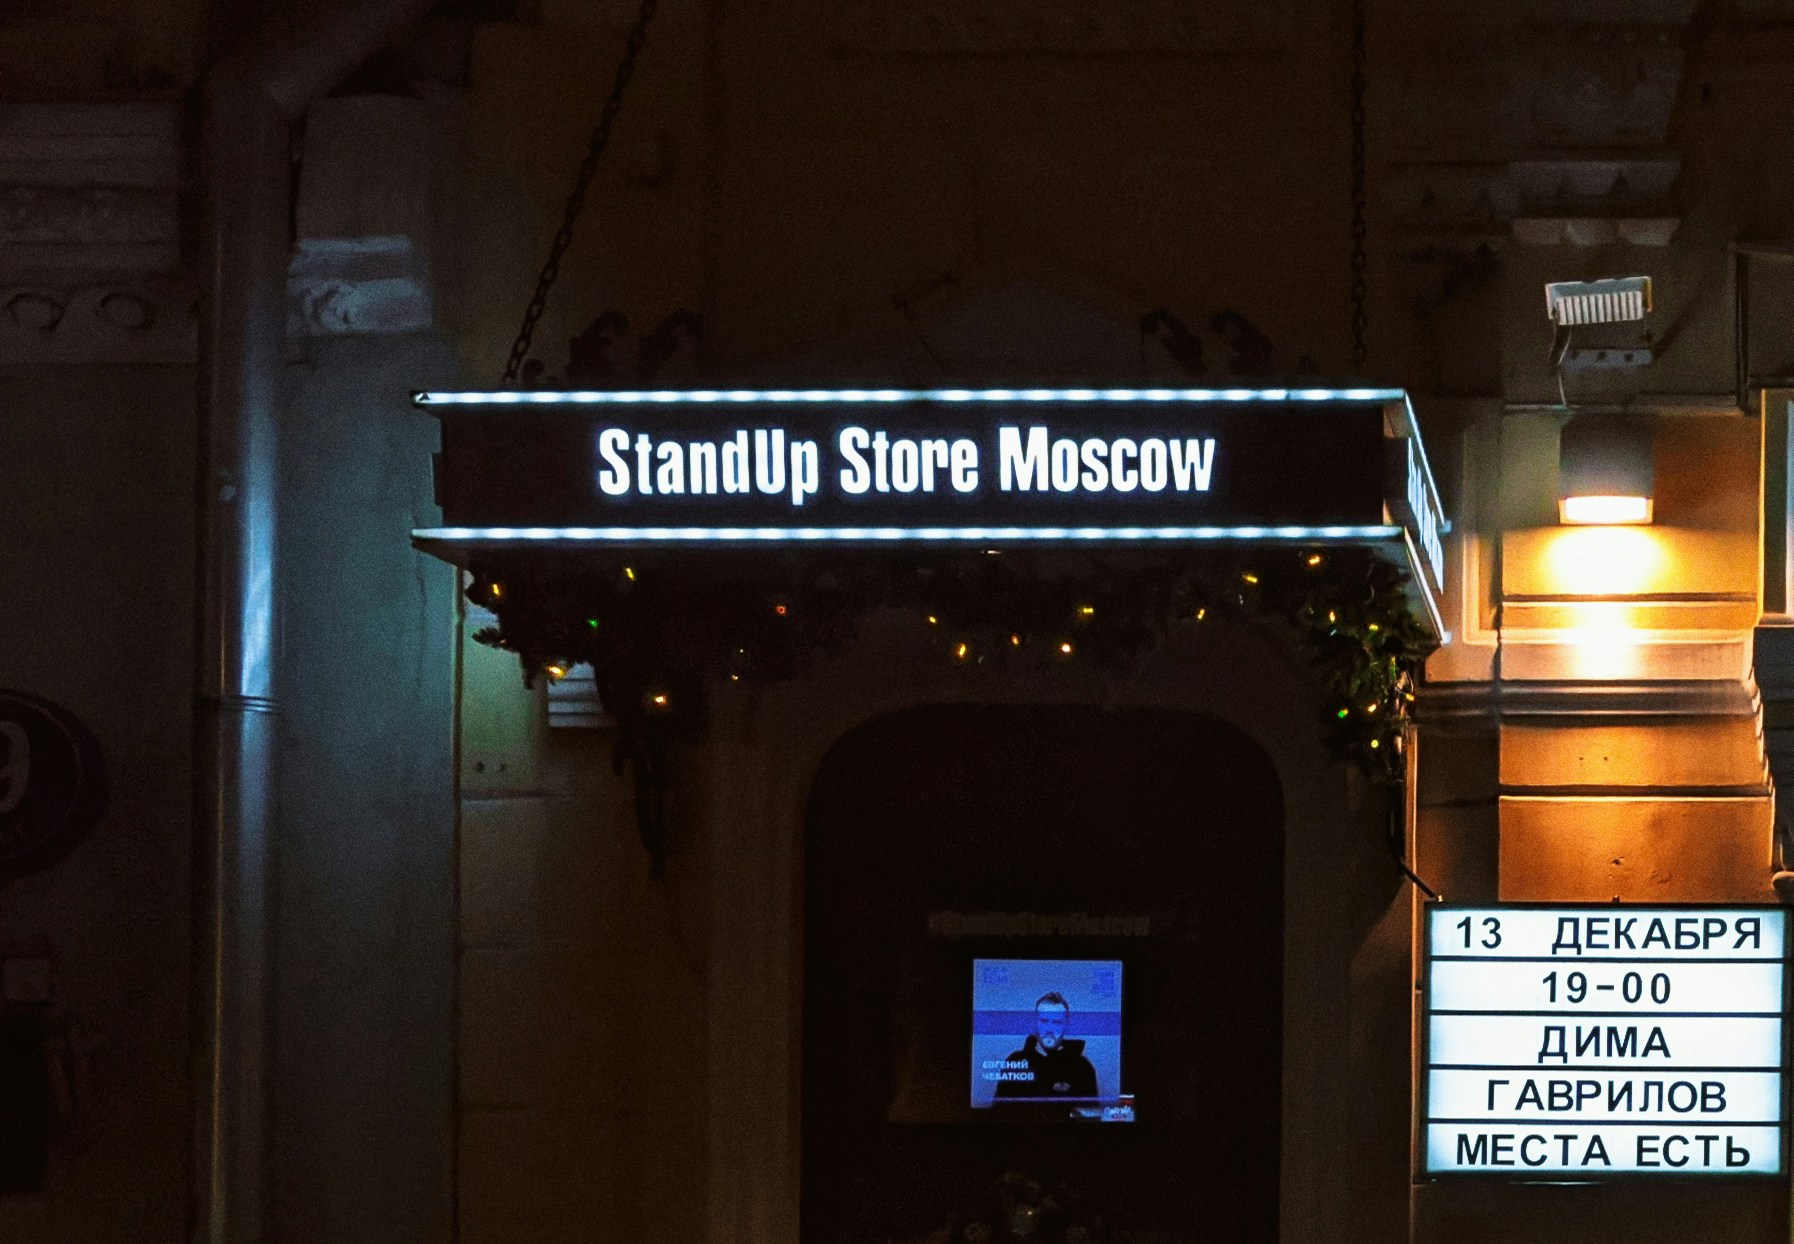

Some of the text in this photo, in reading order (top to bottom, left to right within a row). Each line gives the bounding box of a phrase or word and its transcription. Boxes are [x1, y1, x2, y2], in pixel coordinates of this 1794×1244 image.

[599, 426, 1216, 506] StandUp Store Moscow
[1456, 916, 1761, 955] 13 ДЕКАБРЯ
[1542, 971, 1671, 1005] 19-00
[1537, 1025, 1671, 1064] ДИМА
[1487, 1079, 1727, 1113] ГАВРИЛОВ
[1456, 1133, 1750, 1168] МЕСТА ЕСТЬ
